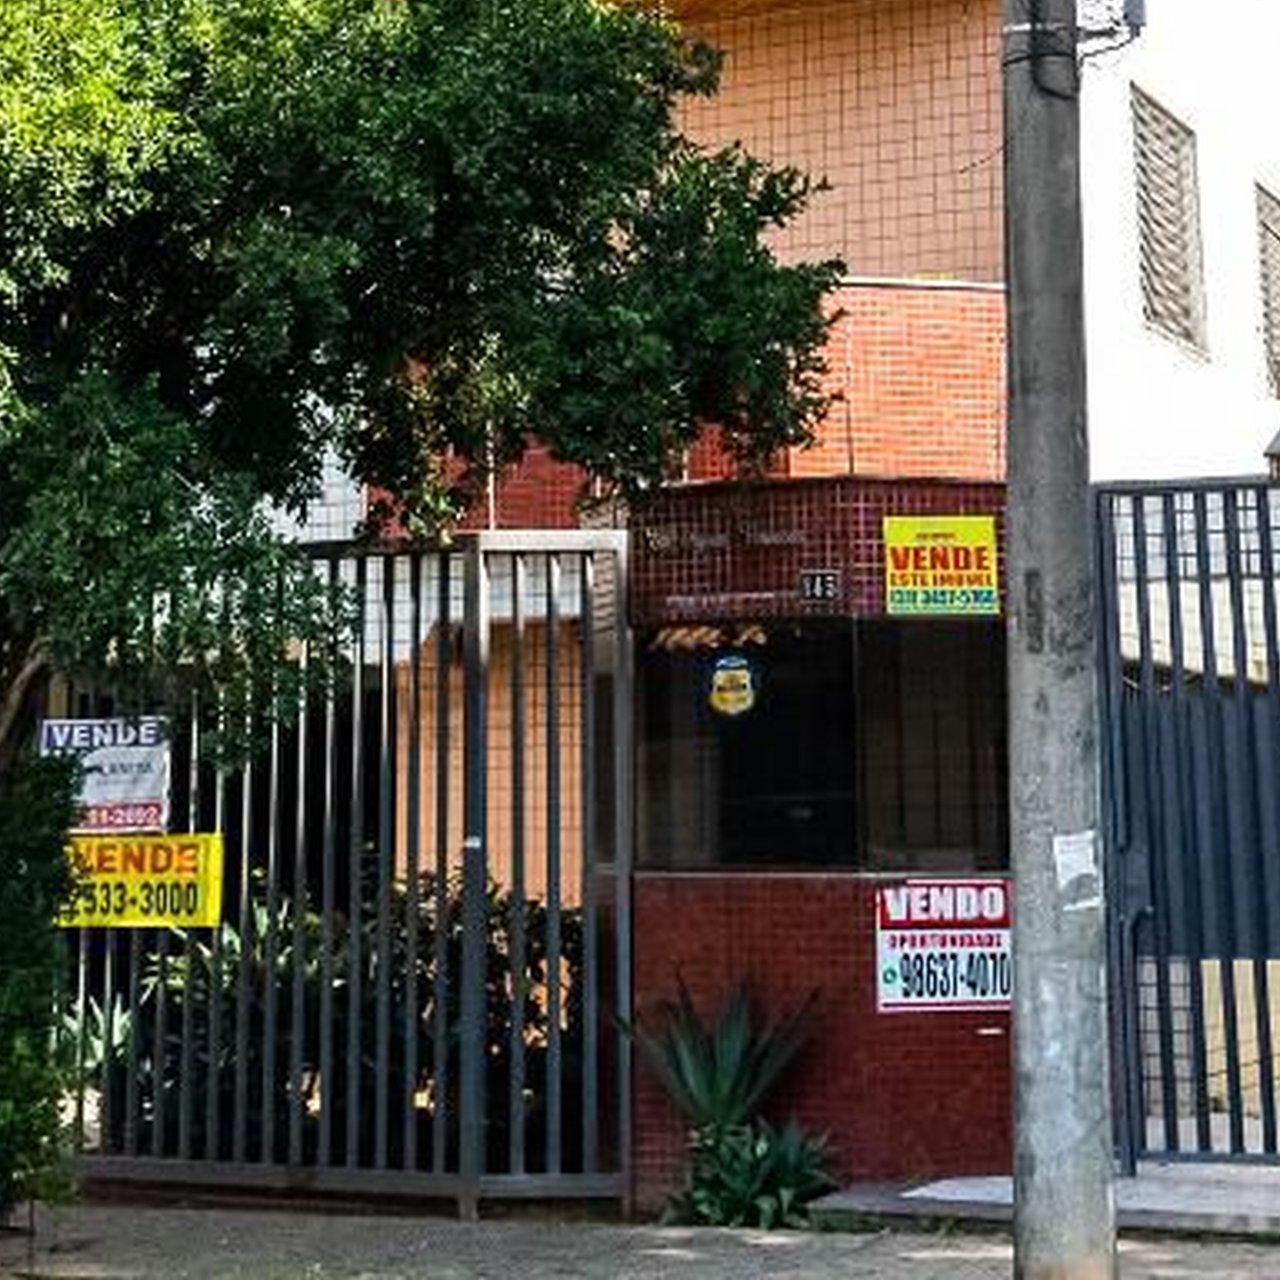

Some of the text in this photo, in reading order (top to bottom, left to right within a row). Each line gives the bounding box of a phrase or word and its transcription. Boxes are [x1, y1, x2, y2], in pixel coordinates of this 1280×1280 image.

[889, 545, 991, 571] VENDE
[889, 572, 929, 588] ESTE
[52, 722, 158, 747] VENDE
[883, 886, 1006, 922] VENDO
[899, 951, 1011, 999] 98637-4070
